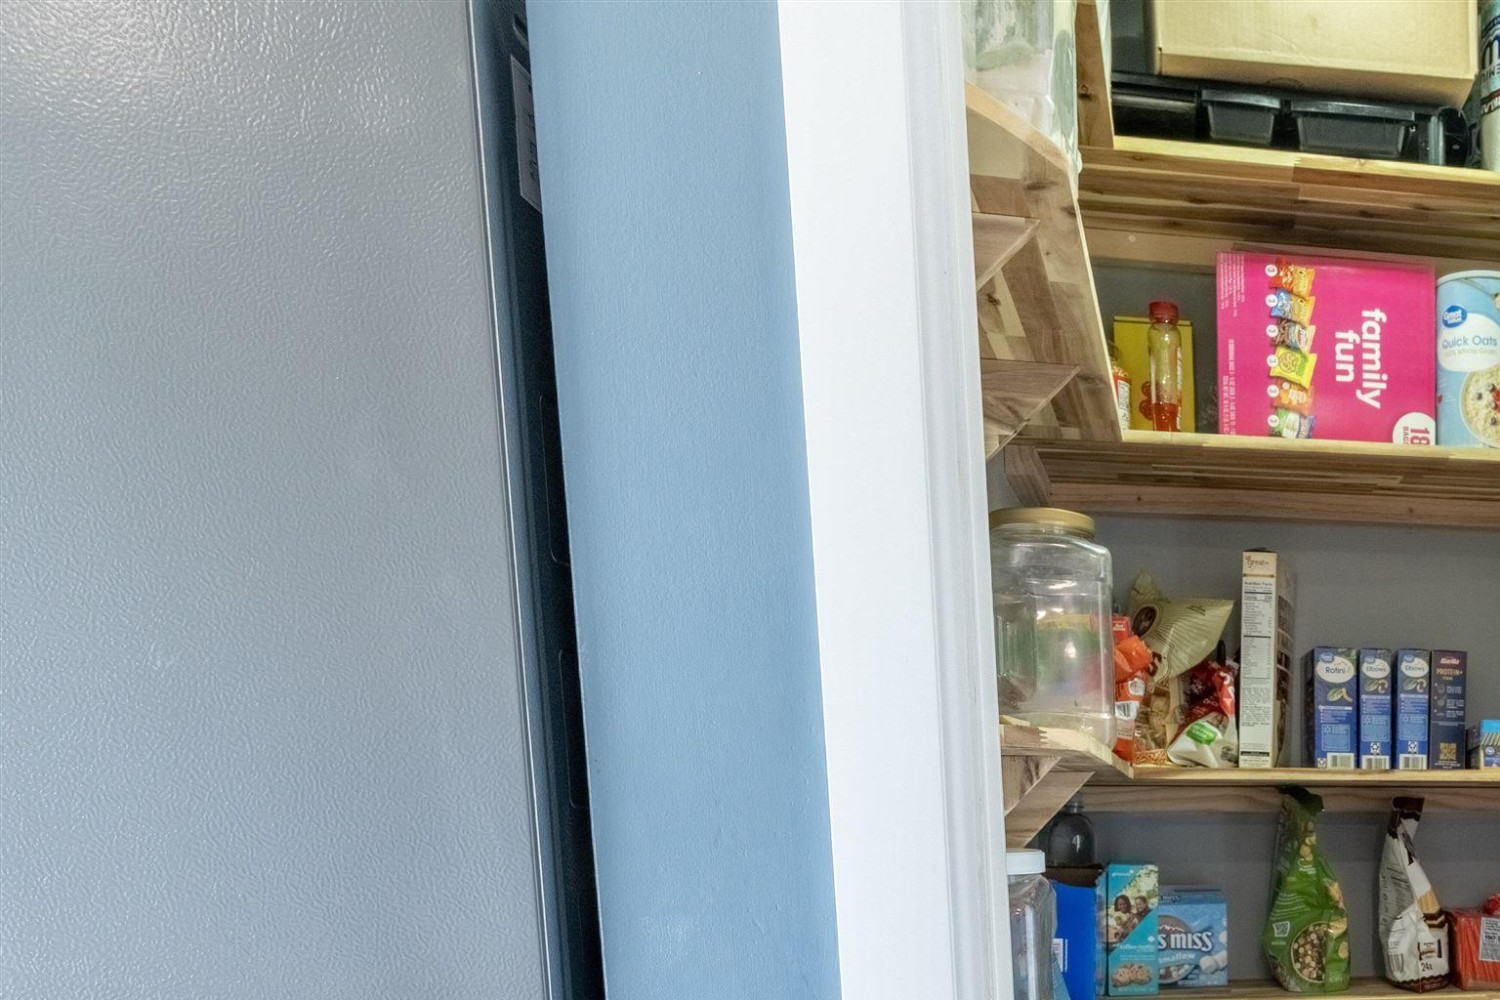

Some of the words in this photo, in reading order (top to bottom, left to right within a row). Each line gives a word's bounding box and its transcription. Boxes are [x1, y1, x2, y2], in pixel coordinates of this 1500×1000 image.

[1335, 330, 1361, 383] fun
[1356, 308, 1389, 409] family
[1441, 335, 1469, 349] Quick
[1471, 335, 1498, 347] Oats
[1325, 666, 1346, 675] Rotini
